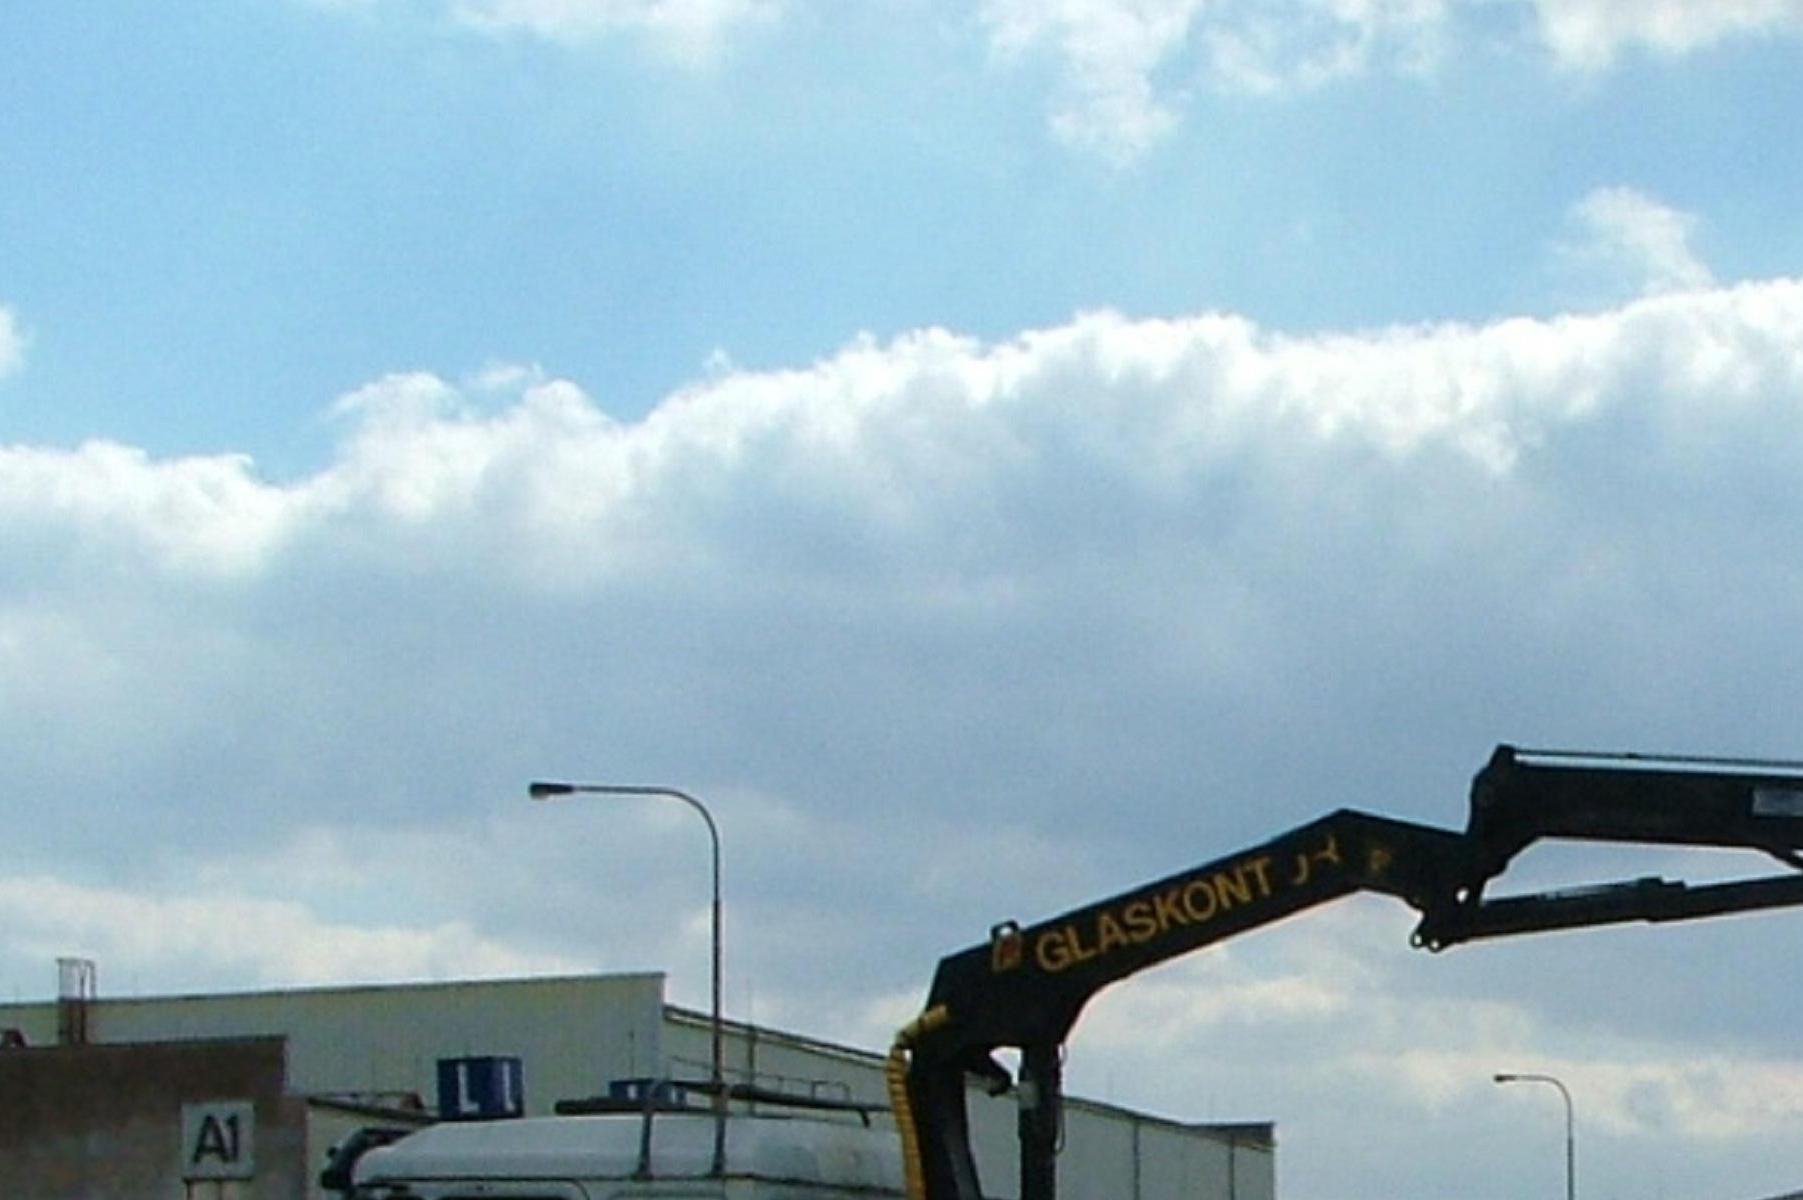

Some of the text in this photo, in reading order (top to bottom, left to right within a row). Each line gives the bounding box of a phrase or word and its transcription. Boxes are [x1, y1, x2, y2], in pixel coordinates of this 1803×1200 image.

[1036, 857, 1272, 971] GLASKONT
[456, 1062, 481, 1113] L
[193, 1114, 239, 1163] A1
